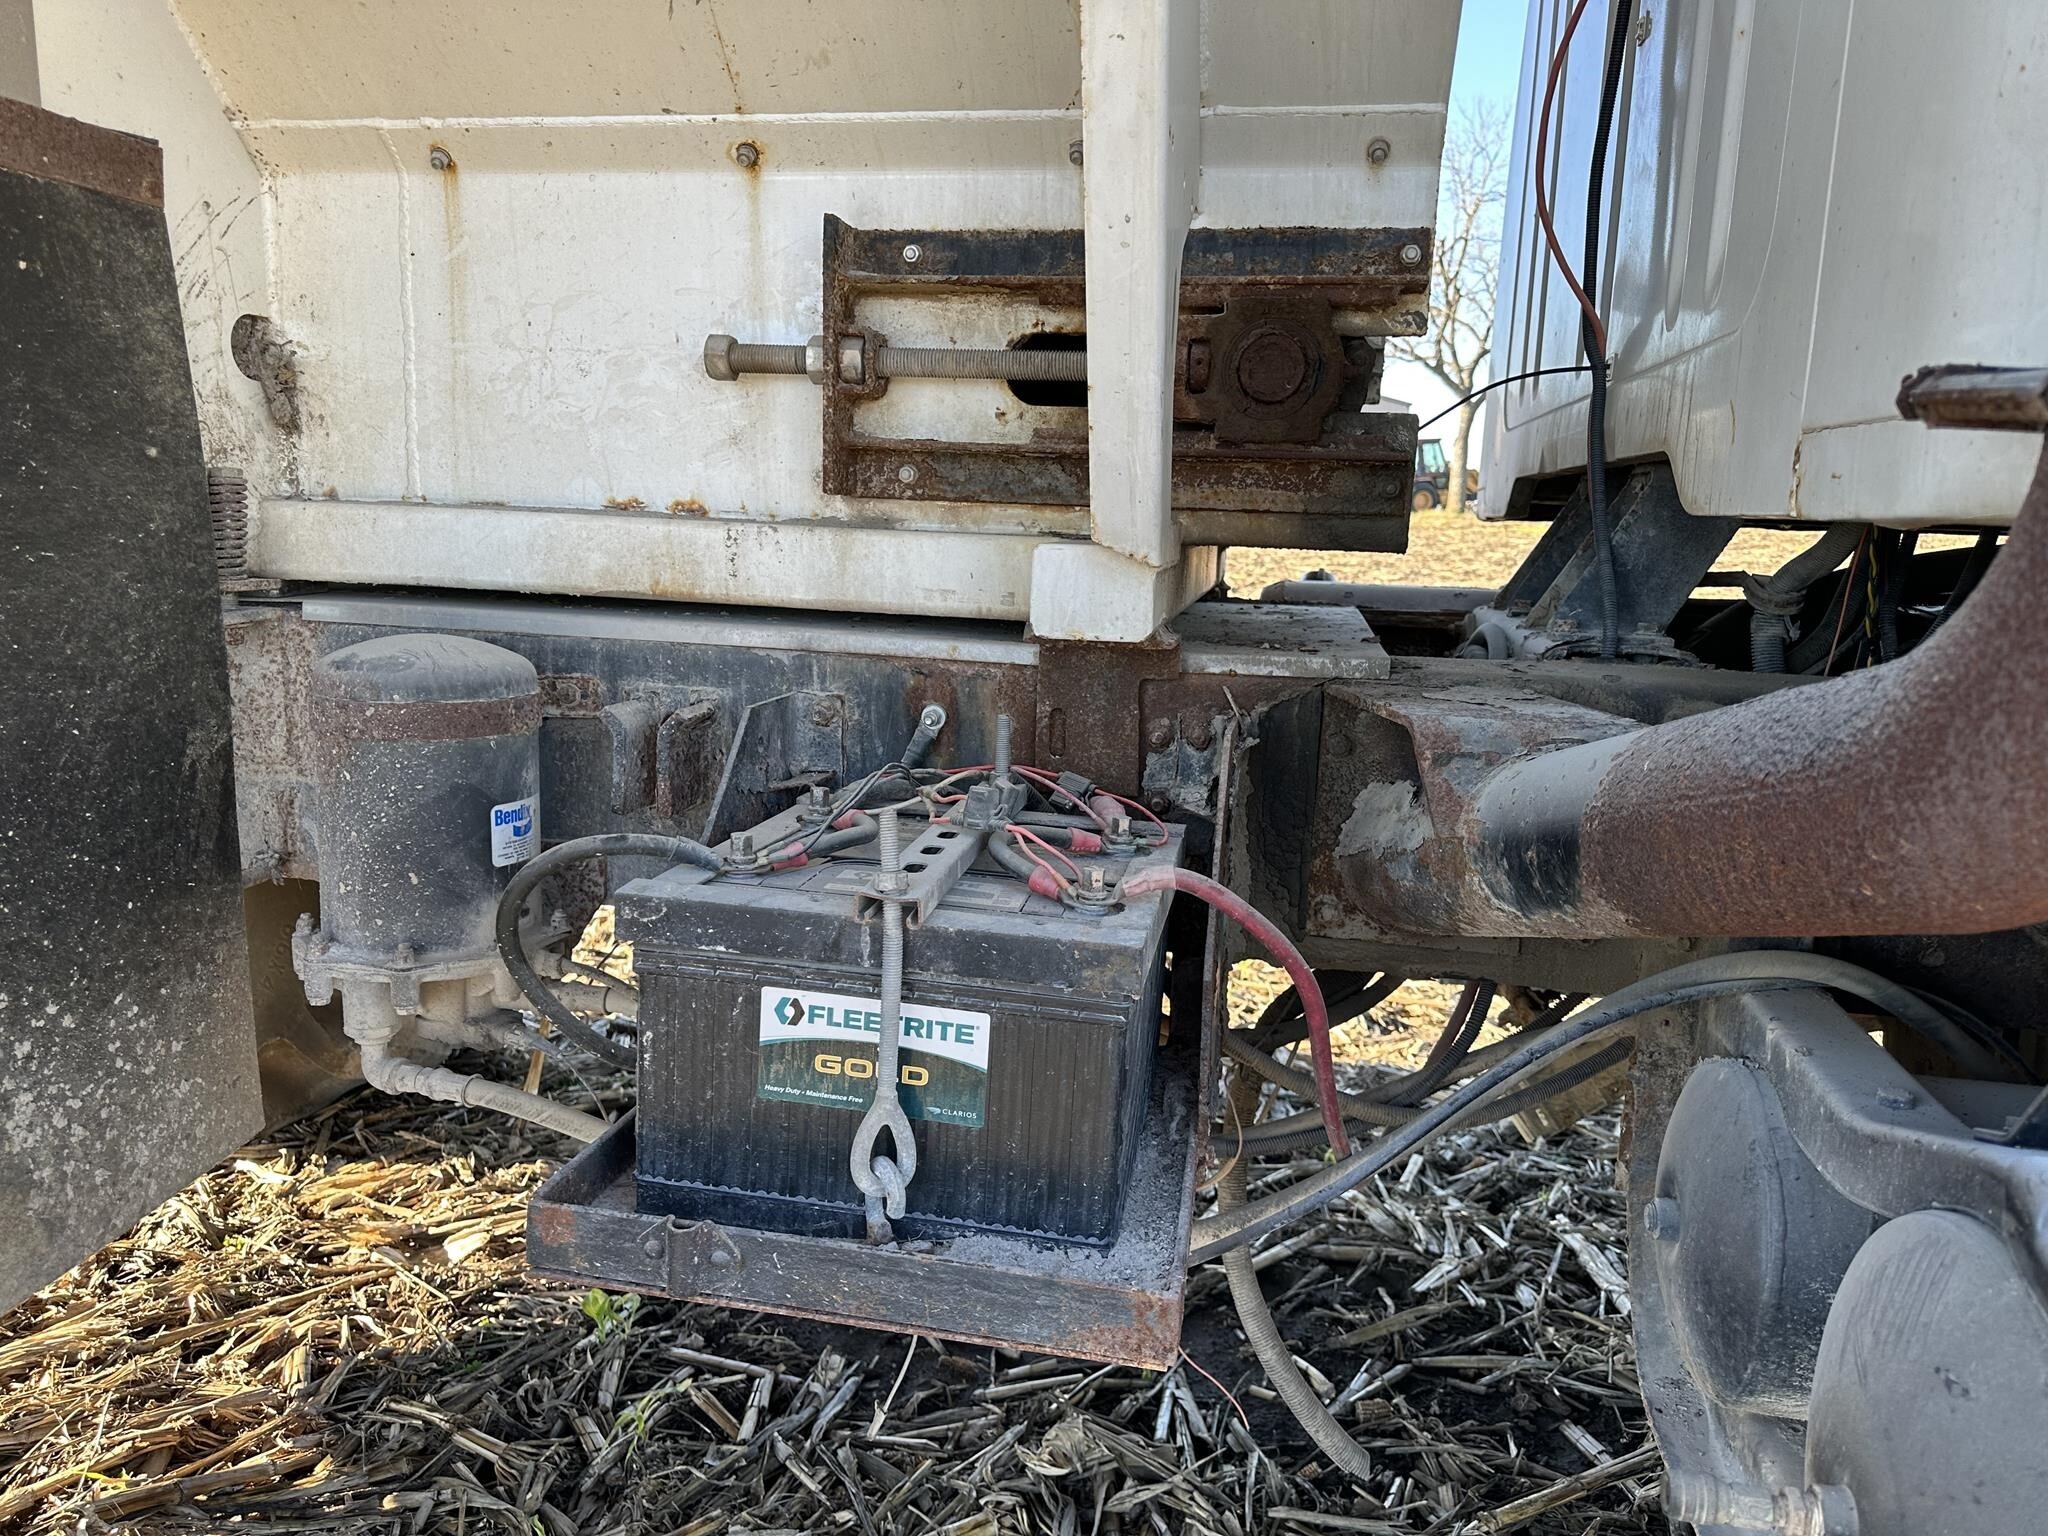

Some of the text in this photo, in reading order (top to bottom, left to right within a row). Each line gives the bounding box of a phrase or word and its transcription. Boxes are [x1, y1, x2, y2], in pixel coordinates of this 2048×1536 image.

[808, 1004, 975, 1044] FLEERITE
[814, 1054, 929, 1087] GOD
[764, 1084, 864, 1103] Heavy Duty Maintenance Free
[942, 1108, 977, 1119] CLARIOS
